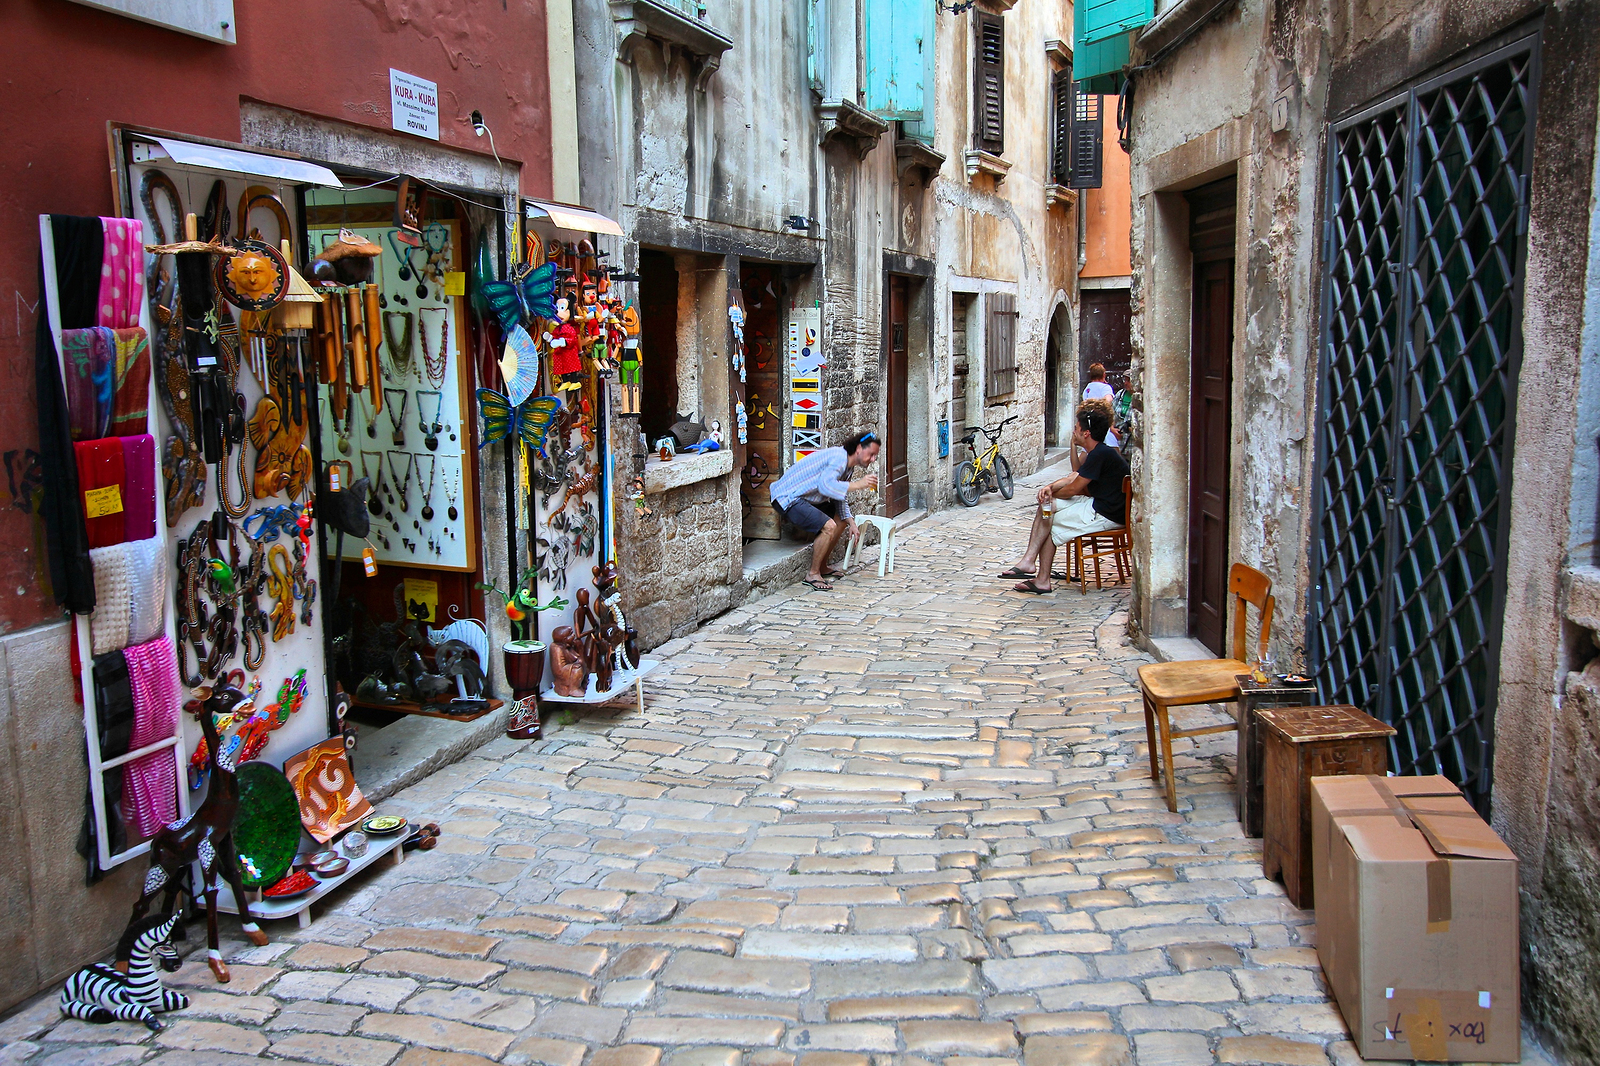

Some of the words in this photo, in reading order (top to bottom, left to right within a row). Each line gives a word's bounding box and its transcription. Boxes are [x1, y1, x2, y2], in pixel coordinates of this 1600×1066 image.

[394, 85, 413, 101] KURA
[418, 92, 436, 107] KURA
[402, 101, 420, 112] Massimo
[407, 119, 428, 132] ROVINJ
